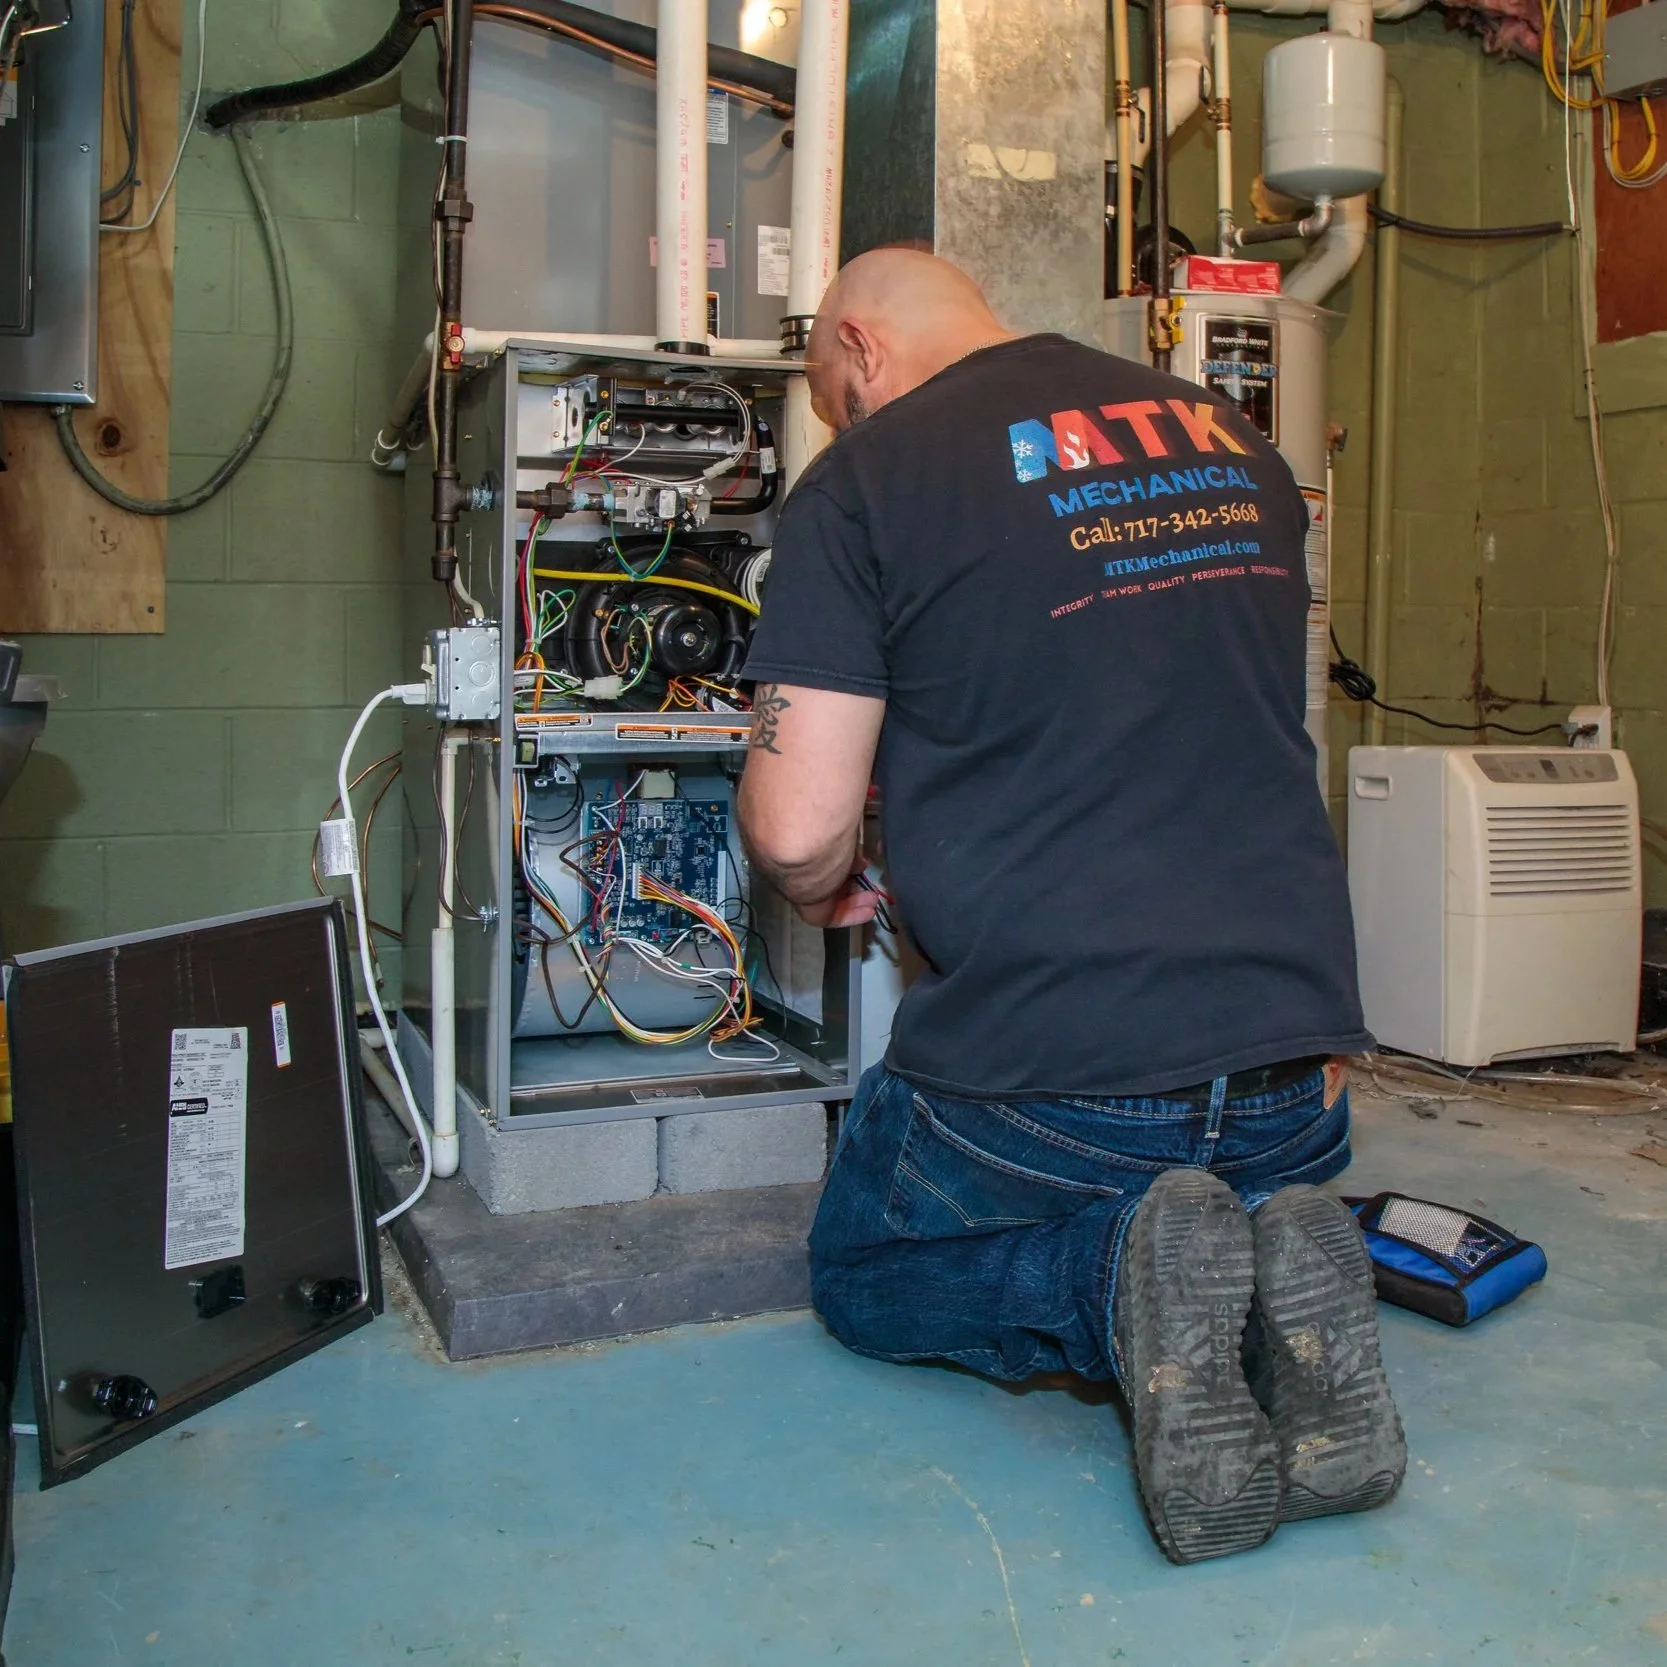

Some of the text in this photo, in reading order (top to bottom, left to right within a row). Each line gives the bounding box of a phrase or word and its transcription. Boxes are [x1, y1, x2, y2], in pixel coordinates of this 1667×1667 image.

[1212, 335, 1248, 345] BRADFORD
[1249, 337, 1269, 347] WHITE
[1201, 360, 1277, 377] DEFENDER
[1213, 377, 1268, 387] SAFE SYSTEM
[1008, 399, 1247, 483] MTK
[1048, 466, 1259, 518] MECHANICAL
[1050, 593, 1094, 619] INTEGRITY
[1101, 589, 1117, 599] TAM
[1119, 584, 1142, 595] WORK
[1148, 575, 1185, 591] QUALITY
[1191, 566, 1246, 581] PERSEVERANCE
[1210, 1303, 1230, 1385] adidas
